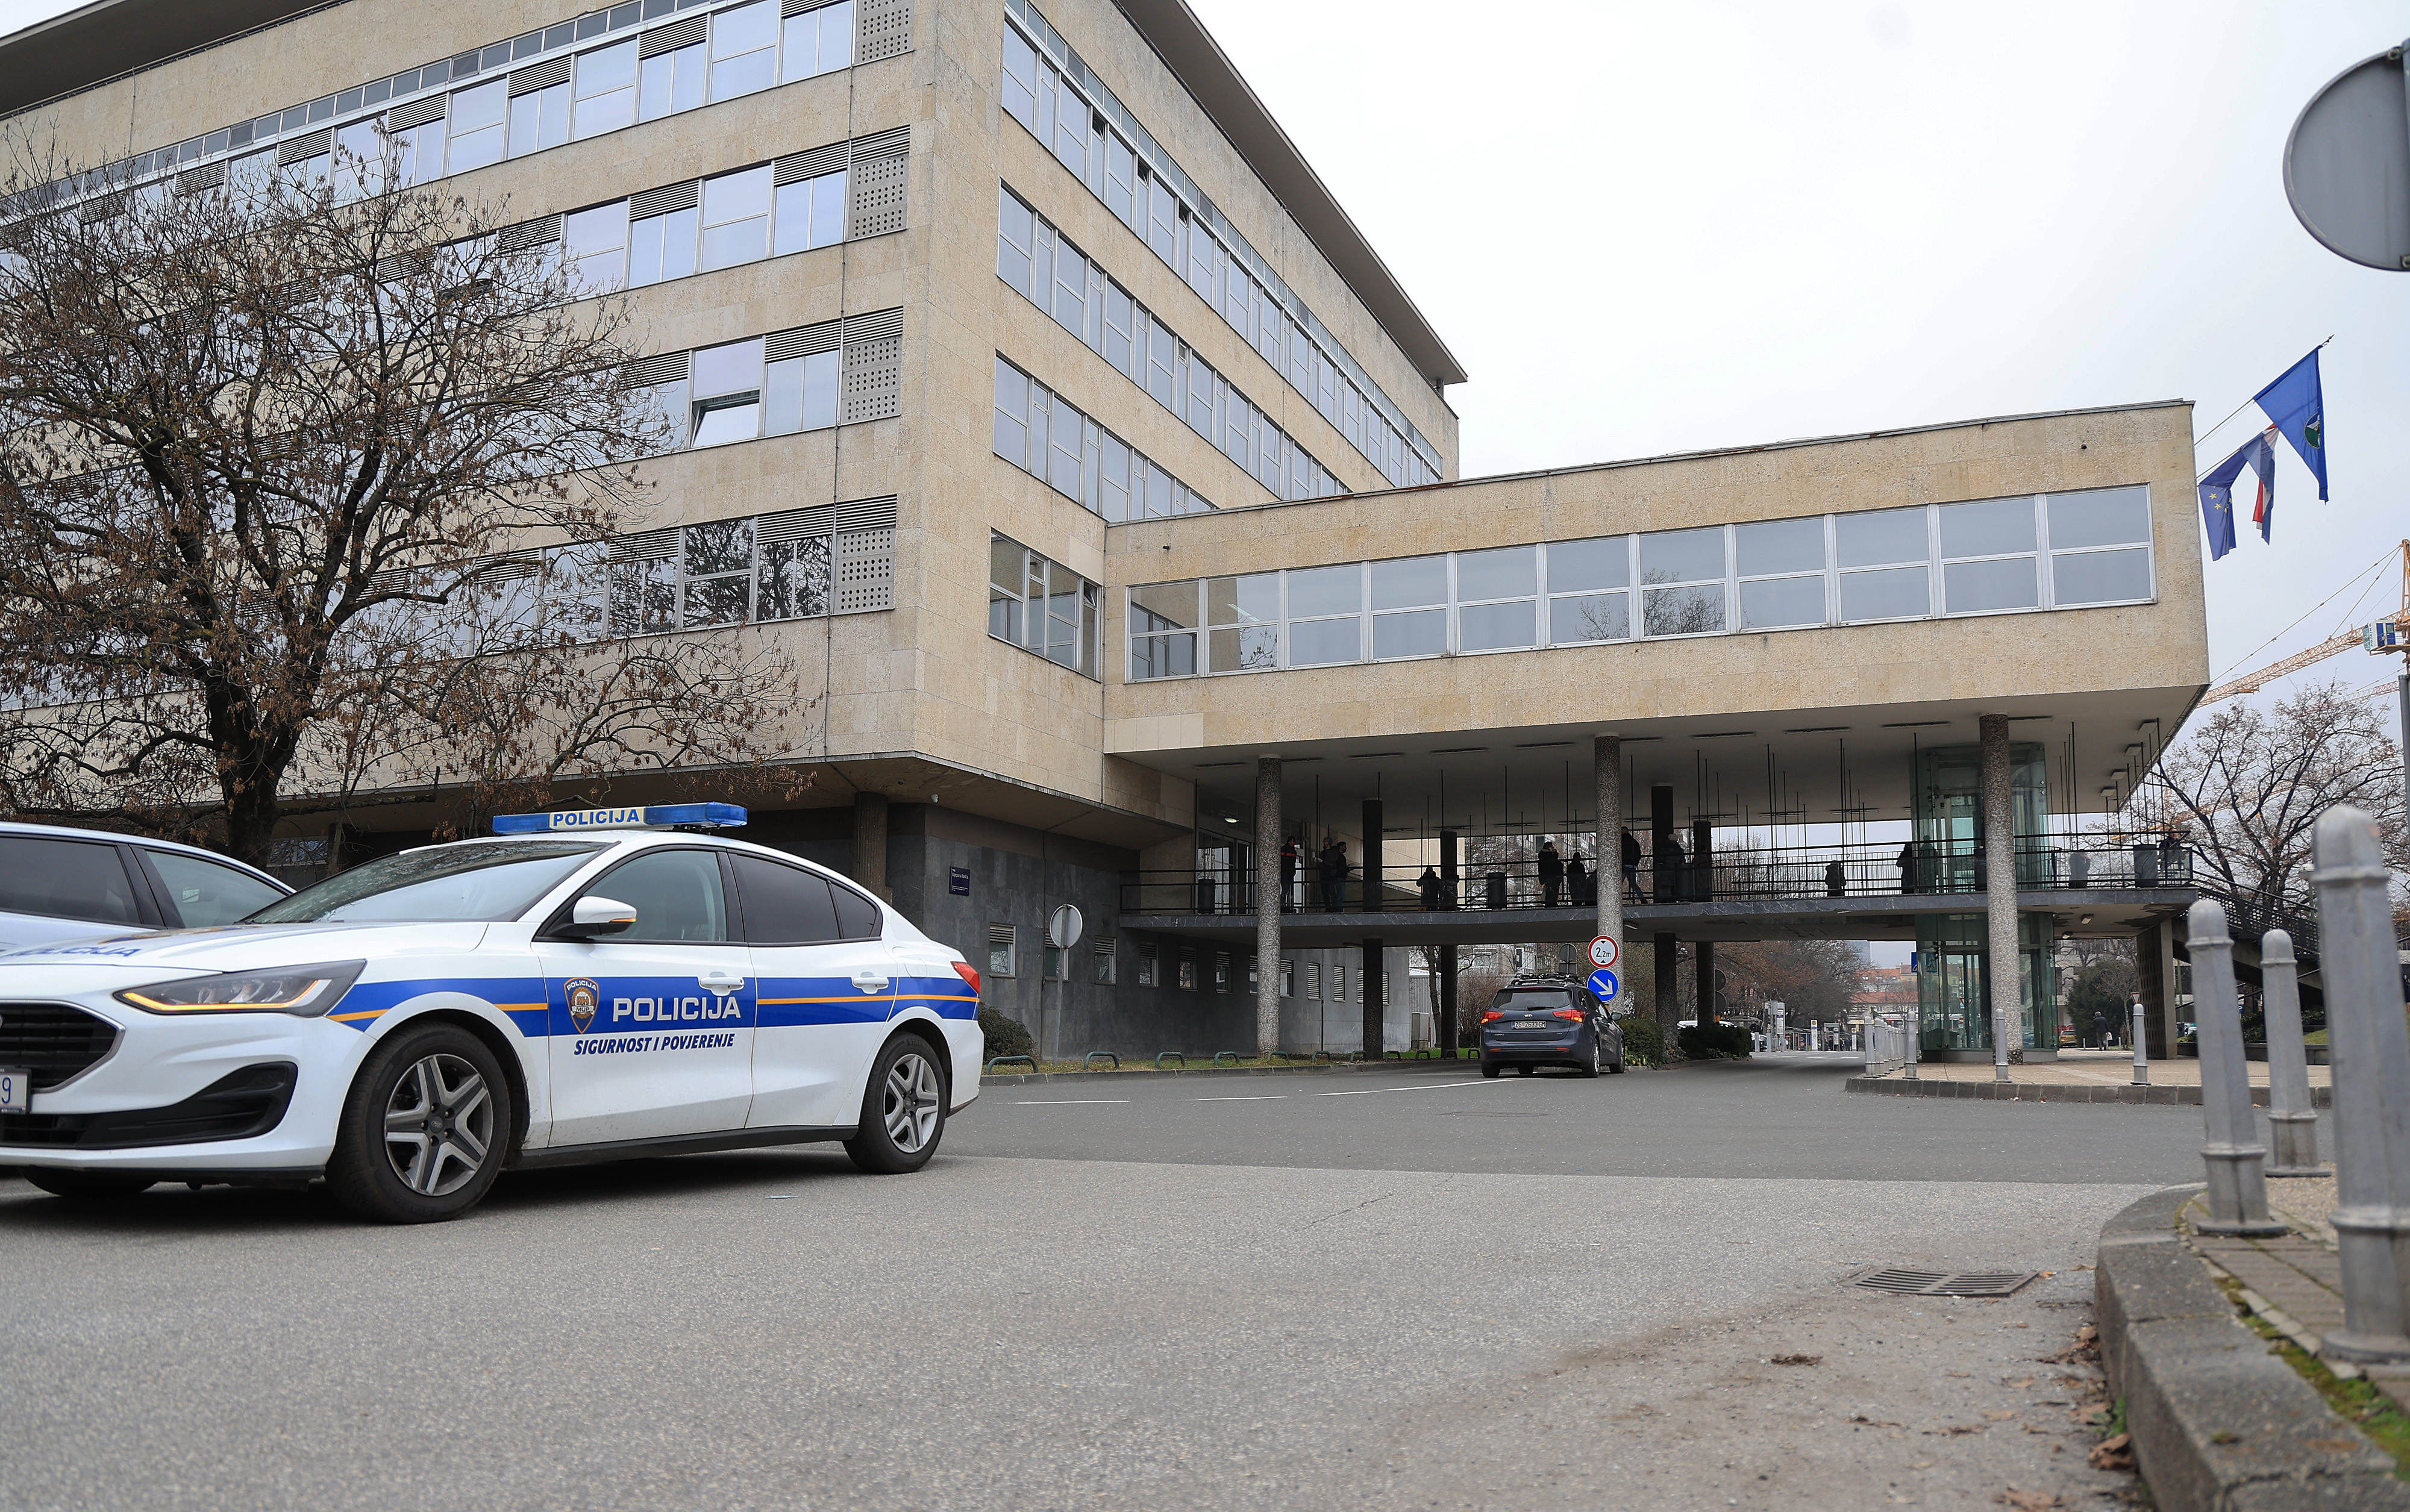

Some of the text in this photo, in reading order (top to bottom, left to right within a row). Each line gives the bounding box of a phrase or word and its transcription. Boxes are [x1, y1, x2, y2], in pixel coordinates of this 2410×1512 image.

[553, 809, 639, 826] POLICIJA
[1595, 947, 1611, 958] 2,2m
[566, 980, 596, 991] POLICIJA
[577, 996, 589, 1005] RH
[613, 996, 741, 1022] POLICIJA
[574, 1033, 736, 1055] SIGURNOST I POVJERENJE
